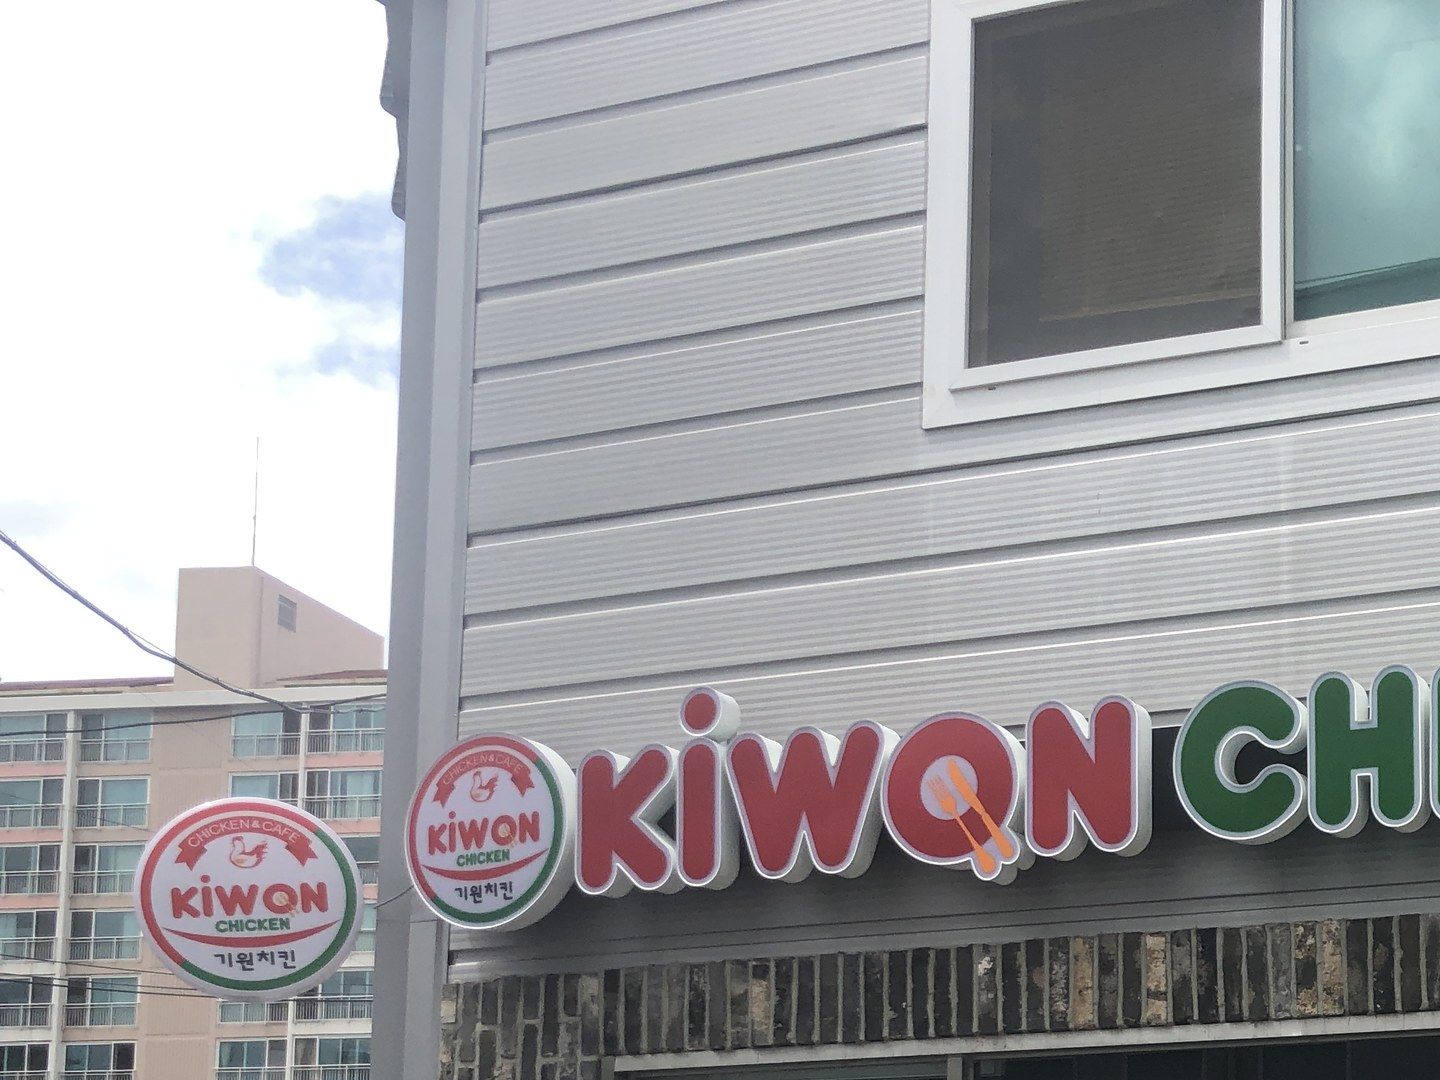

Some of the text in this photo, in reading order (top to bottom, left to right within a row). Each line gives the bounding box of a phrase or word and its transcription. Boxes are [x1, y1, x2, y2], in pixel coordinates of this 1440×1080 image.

[456, 849, 511, 867] CHICKEN
[454, 880, 514, 904] 기원치킨
[214, 917, 291, 933] CHICKEN
[213, 949, 297, 972] 기원치킨
